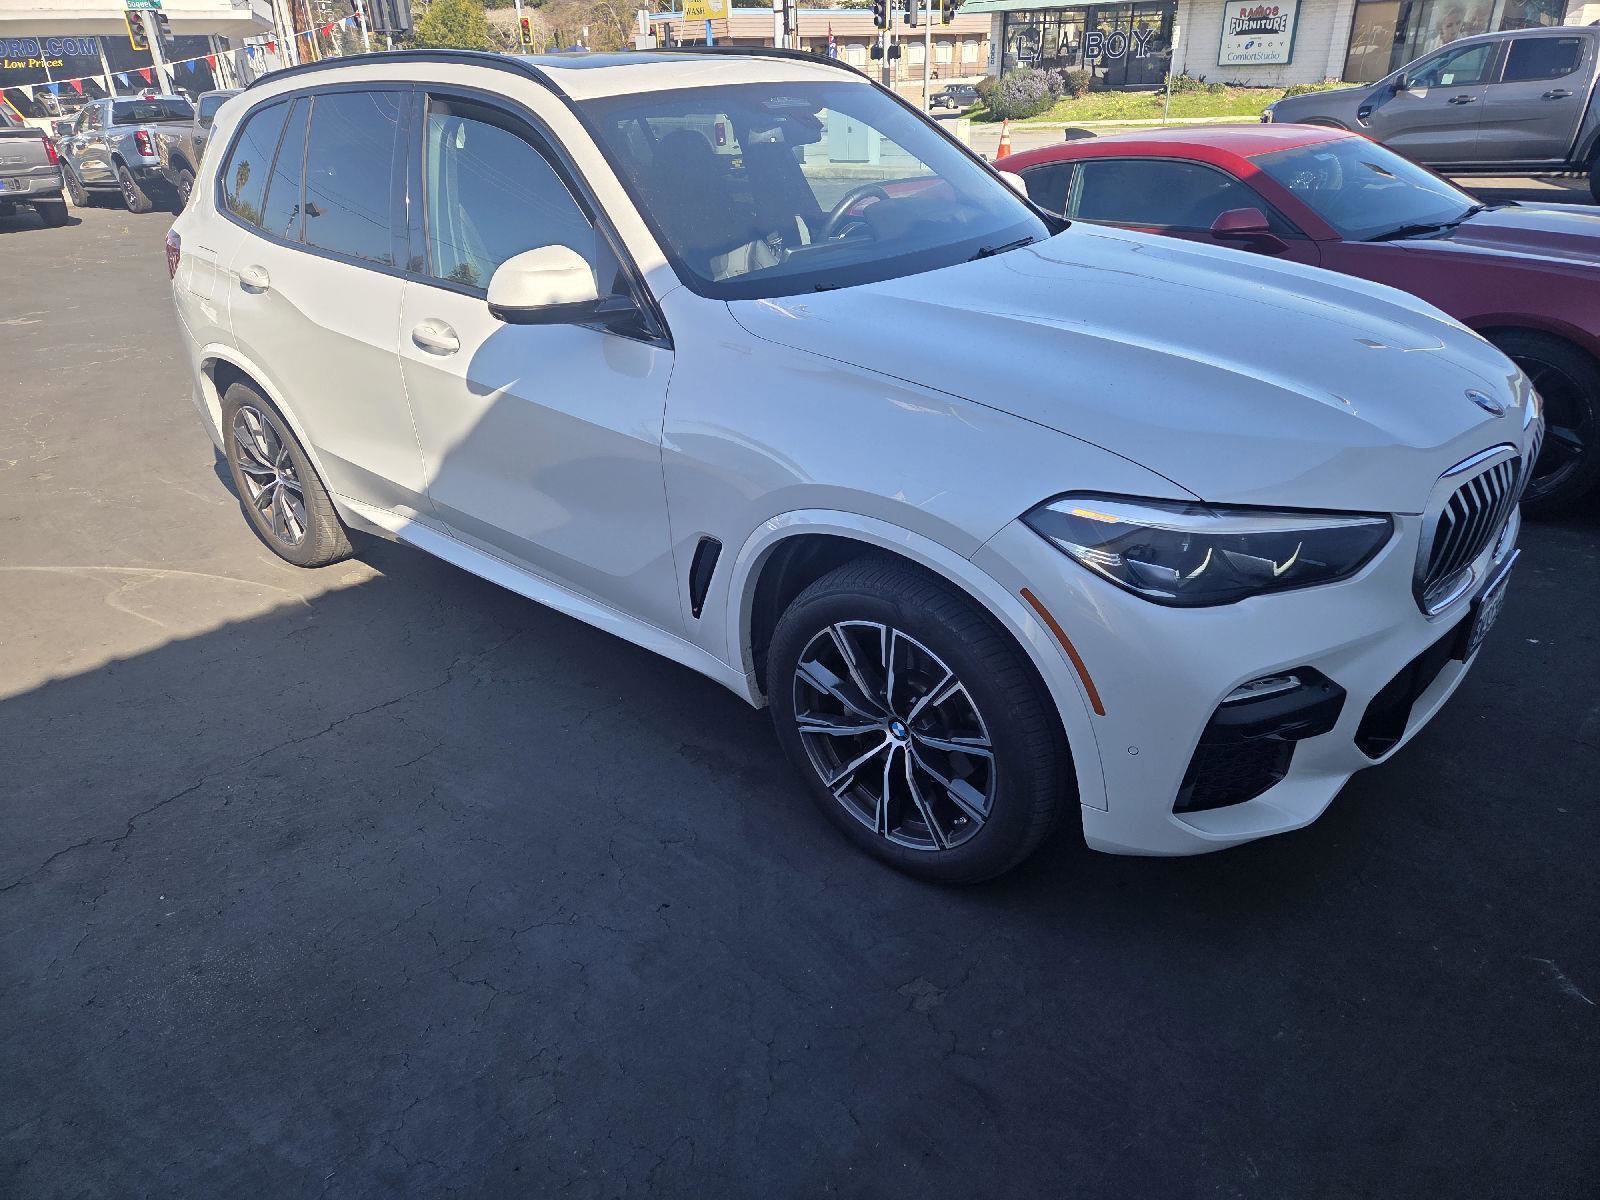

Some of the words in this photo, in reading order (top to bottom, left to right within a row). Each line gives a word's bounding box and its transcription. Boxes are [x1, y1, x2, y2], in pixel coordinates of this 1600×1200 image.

[1240, 6, 1279, 18] RAMOS
[1230, 15, 1287, 35] FURNITURE
[1085, 29, 1154, 60] BOY
[4, 59, 26, 69] Low
[28, 58, 64, 68] Prices
